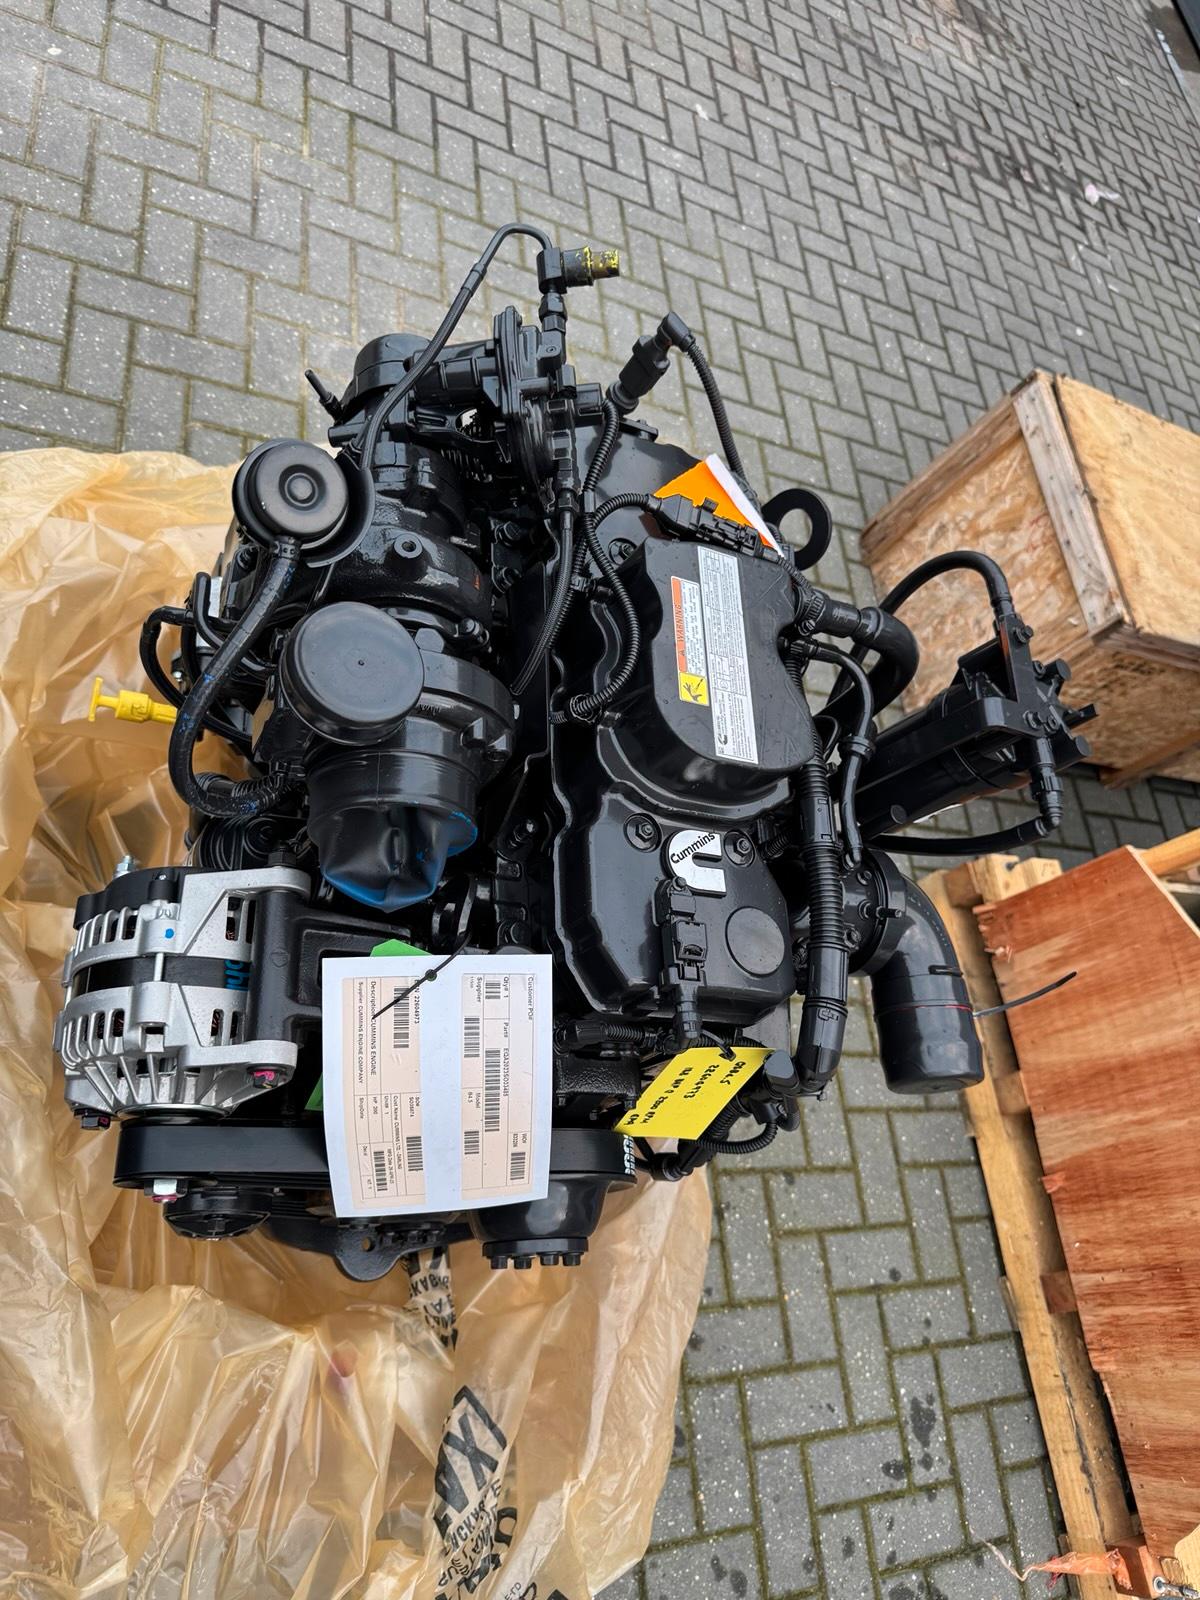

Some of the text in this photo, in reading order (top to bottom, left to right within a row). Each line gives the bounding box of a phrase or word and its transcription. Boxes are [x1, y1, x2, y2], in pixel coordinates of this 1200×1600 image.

[674, 604, 684, 641] WARNING
[670, 832, 716, 864] Cummins
[475, 976, 483, 1003] Supplier
[357, 1055, 365, 1083] COMPANY
